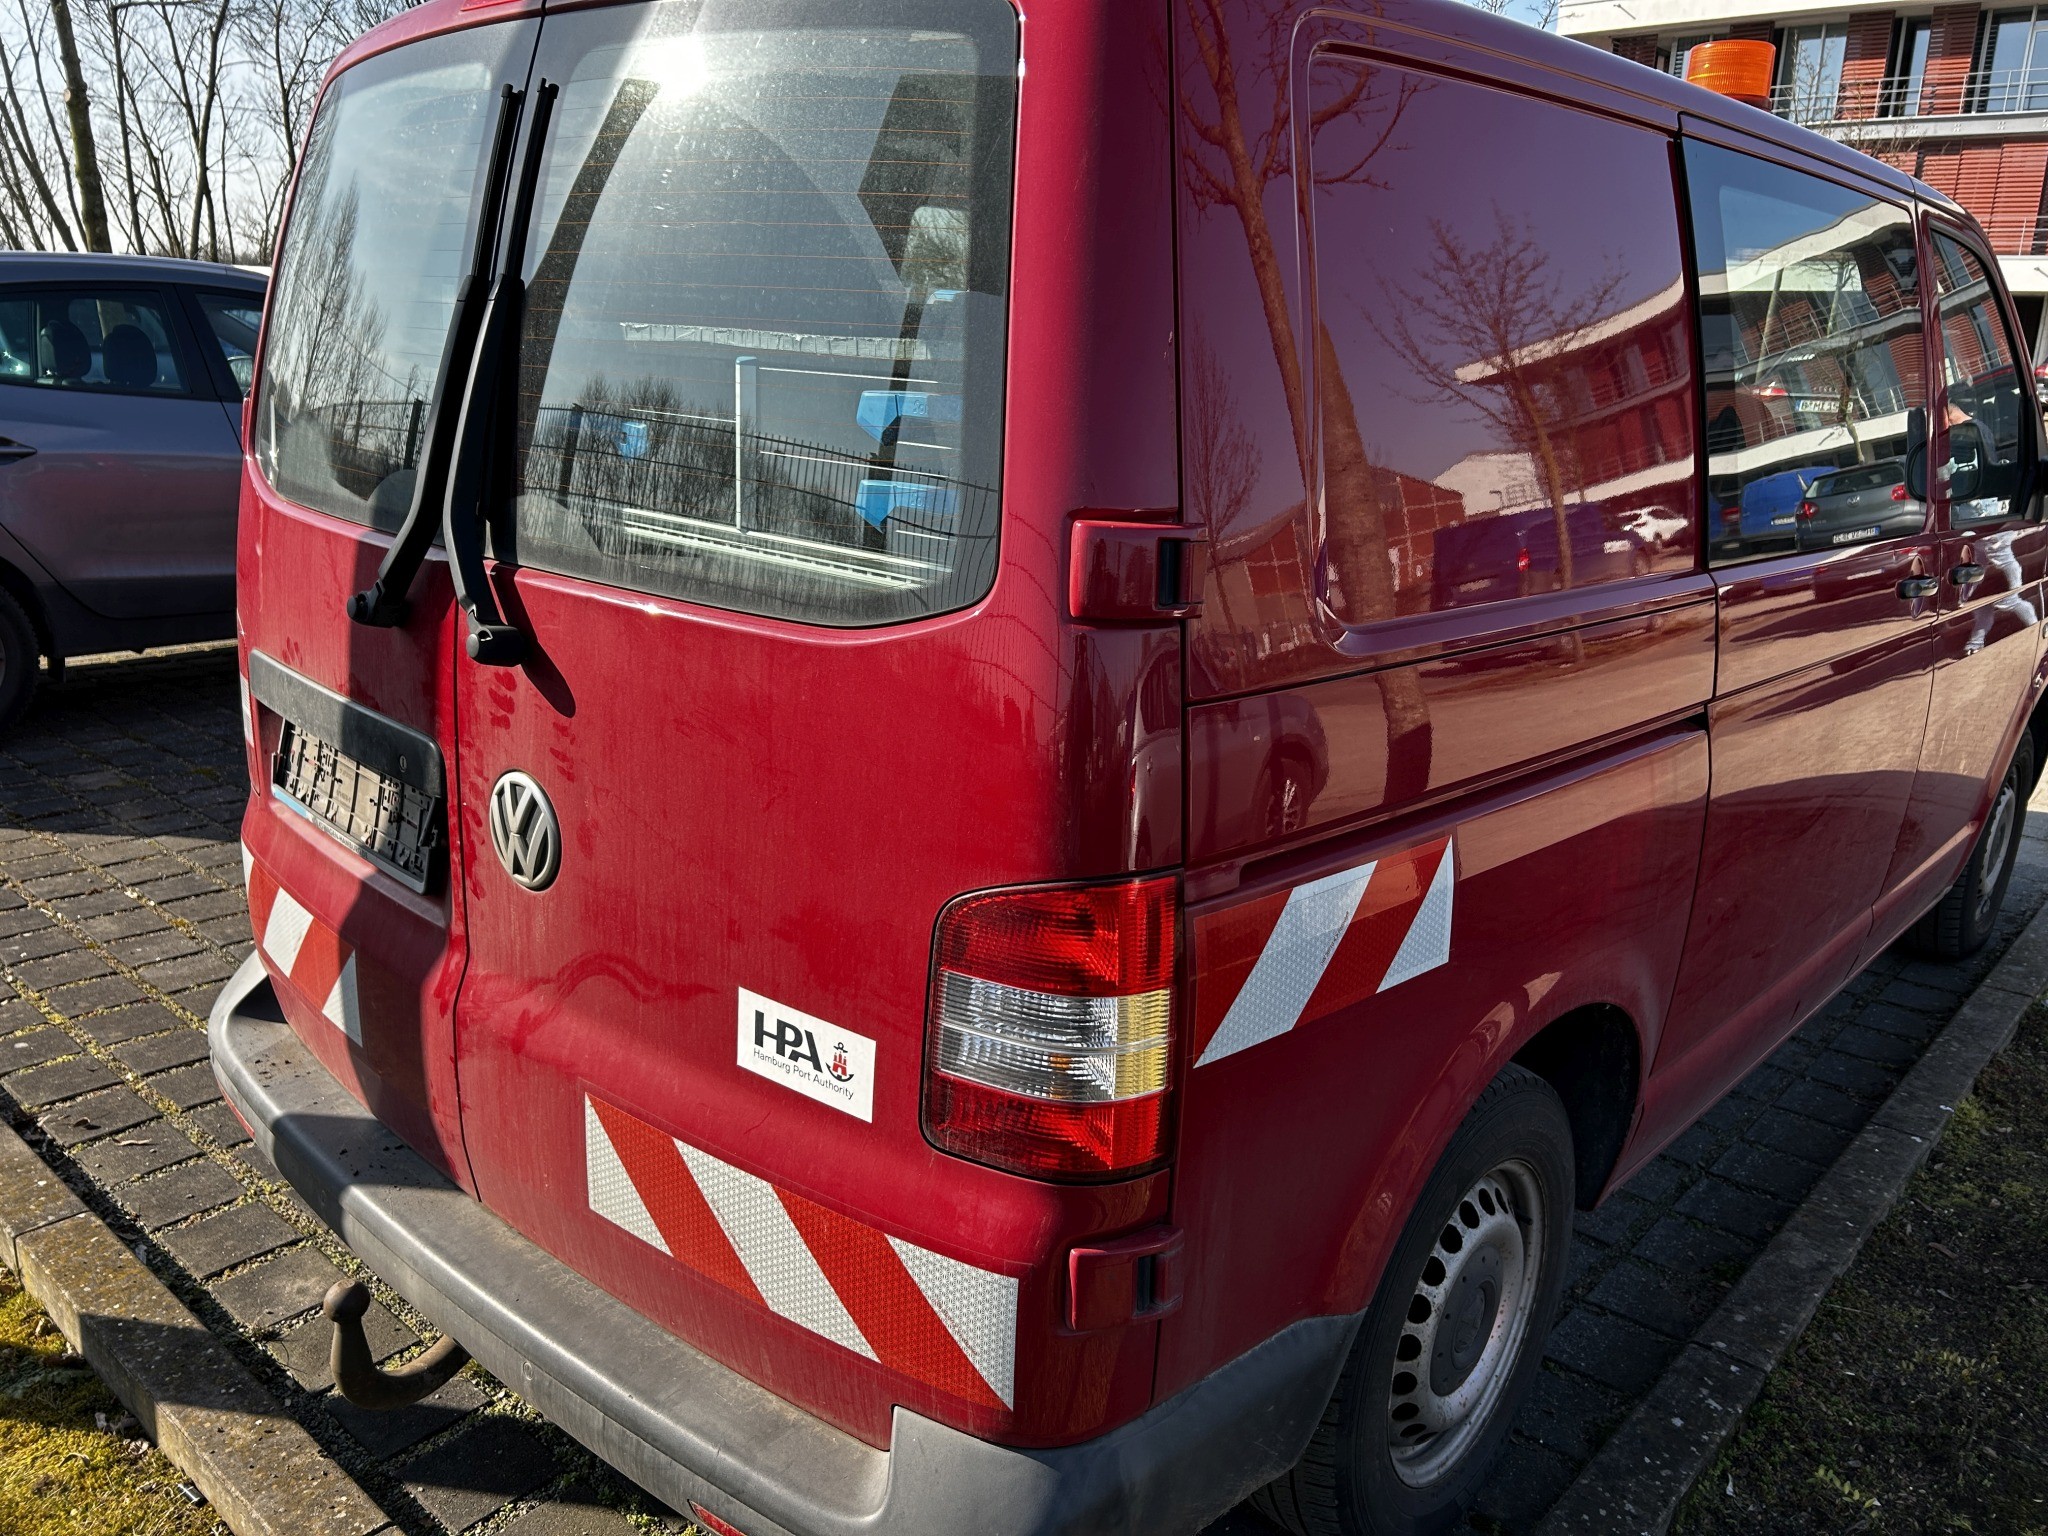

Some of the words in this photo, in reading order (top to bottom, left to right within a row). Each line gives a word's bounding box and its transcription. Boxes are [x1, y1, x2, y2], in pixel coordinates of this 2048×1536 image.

[754, 1009, 823, 1073] HPA
[753, 1048, 790, 1074] Hamburg
[794, 1065, 811, 1082] Port
[813, 1074, 854, 1100] Authority
